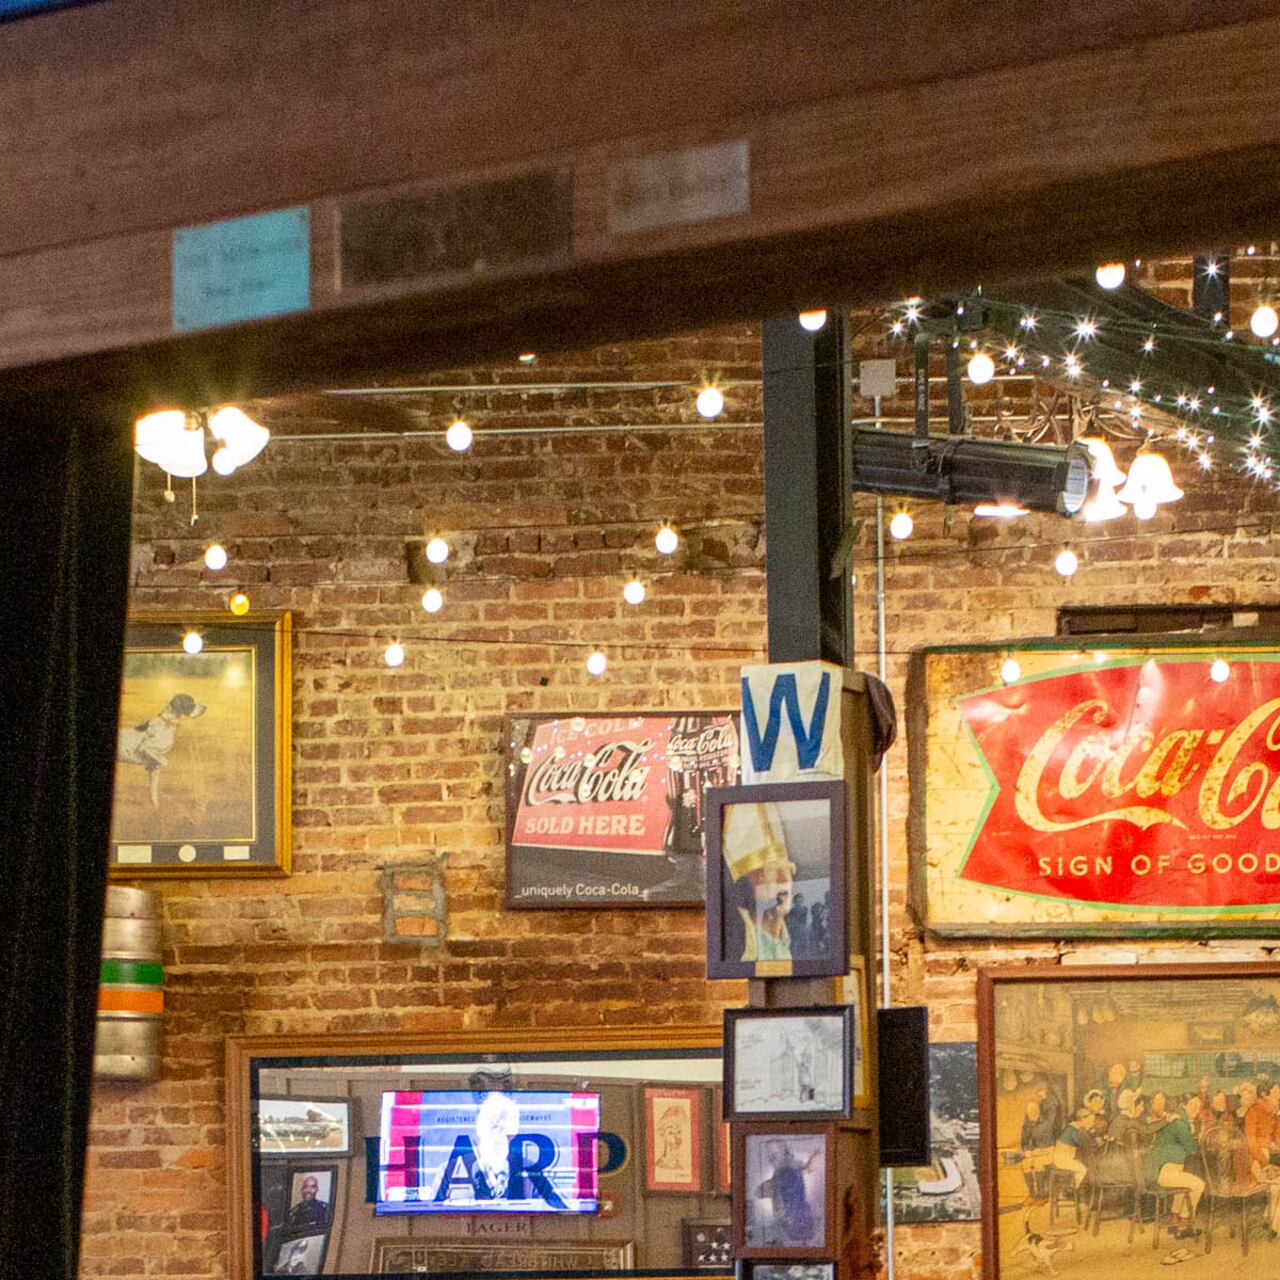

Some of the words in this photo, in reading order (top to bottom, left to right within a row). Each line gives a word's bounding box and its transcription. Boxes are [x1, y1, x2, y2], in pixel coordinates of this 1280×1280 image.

[741, 672, 830, 772] W
[526, 737, 656, 805] CocaCola
[525, 816, 574, 834] SOLD
[578, 813, 646, 836] HERE
[1038, 855, 1113, 877] SIGN
[1130, 854, 1171, 876] OF
[364, 1131, 631, 1210] HARP
[466, 1222, 530, 1234] LAGER
